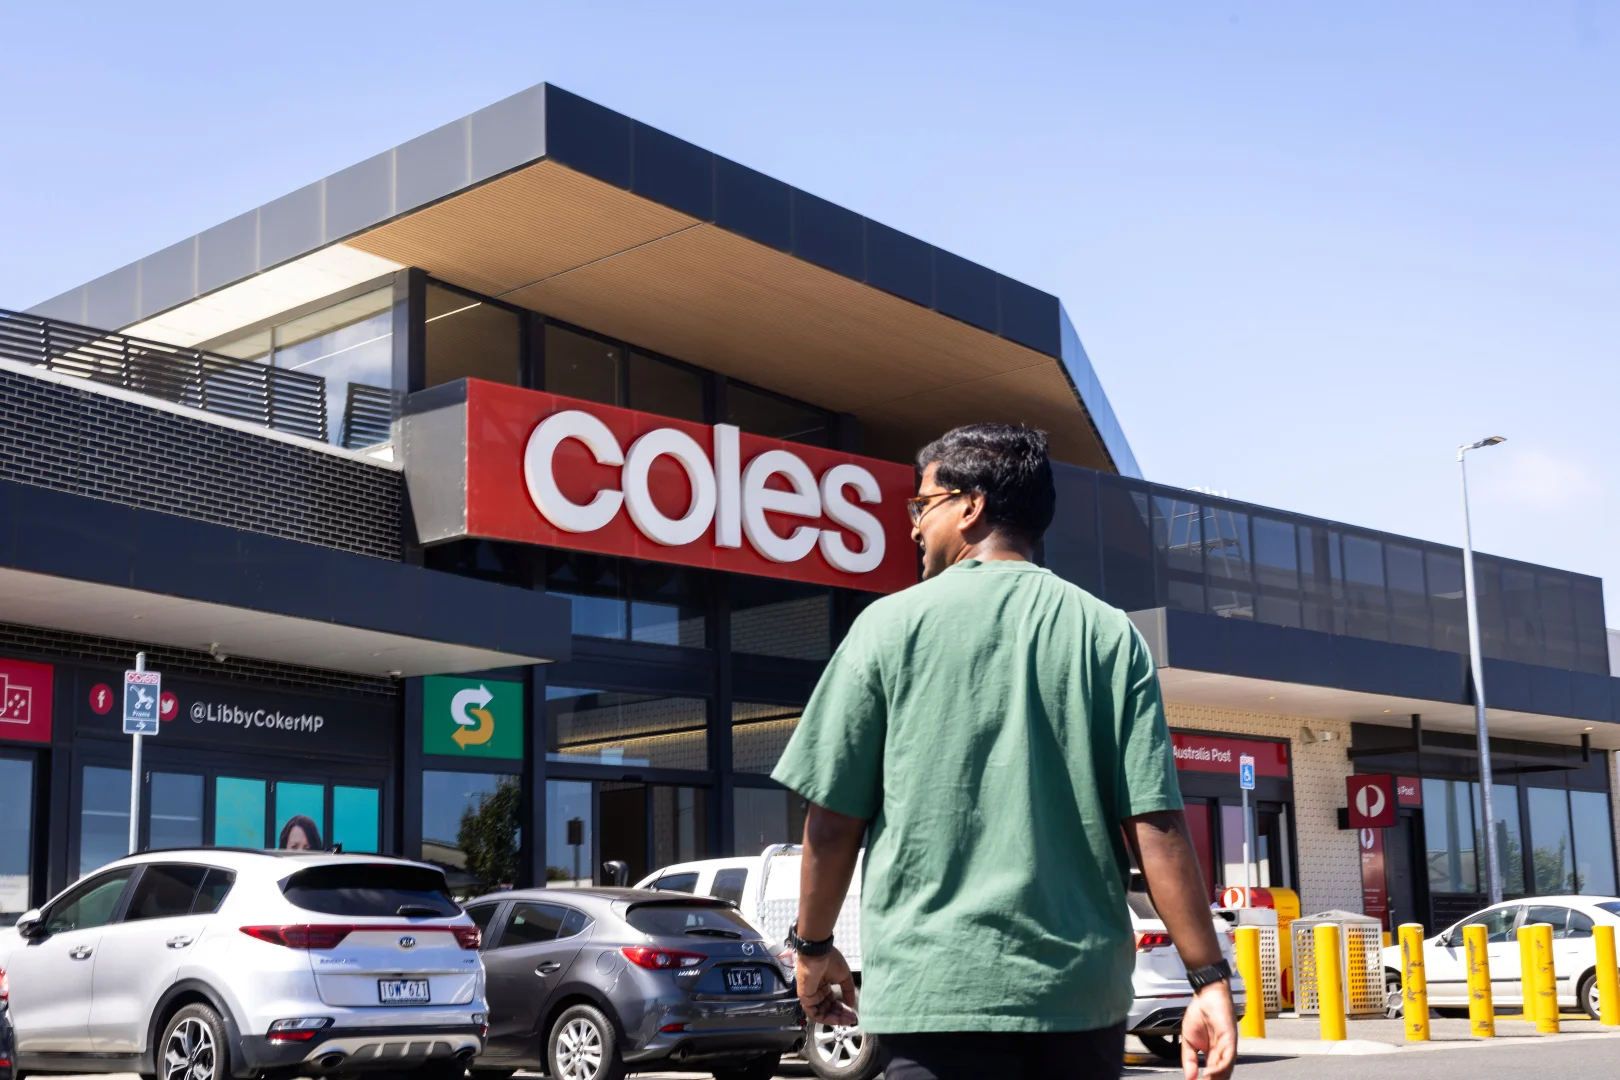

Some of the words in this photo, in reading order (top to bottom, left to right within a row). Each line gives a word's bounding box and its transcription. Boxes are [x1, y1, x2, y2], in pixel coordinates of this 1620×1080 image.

[523, 409, 886, 574] coles
[190, 701, 324, 733] @LibbyCokerMP
[1172, 744, 1210, 761] Australia
[1212, 748, 1231, 763] Post
